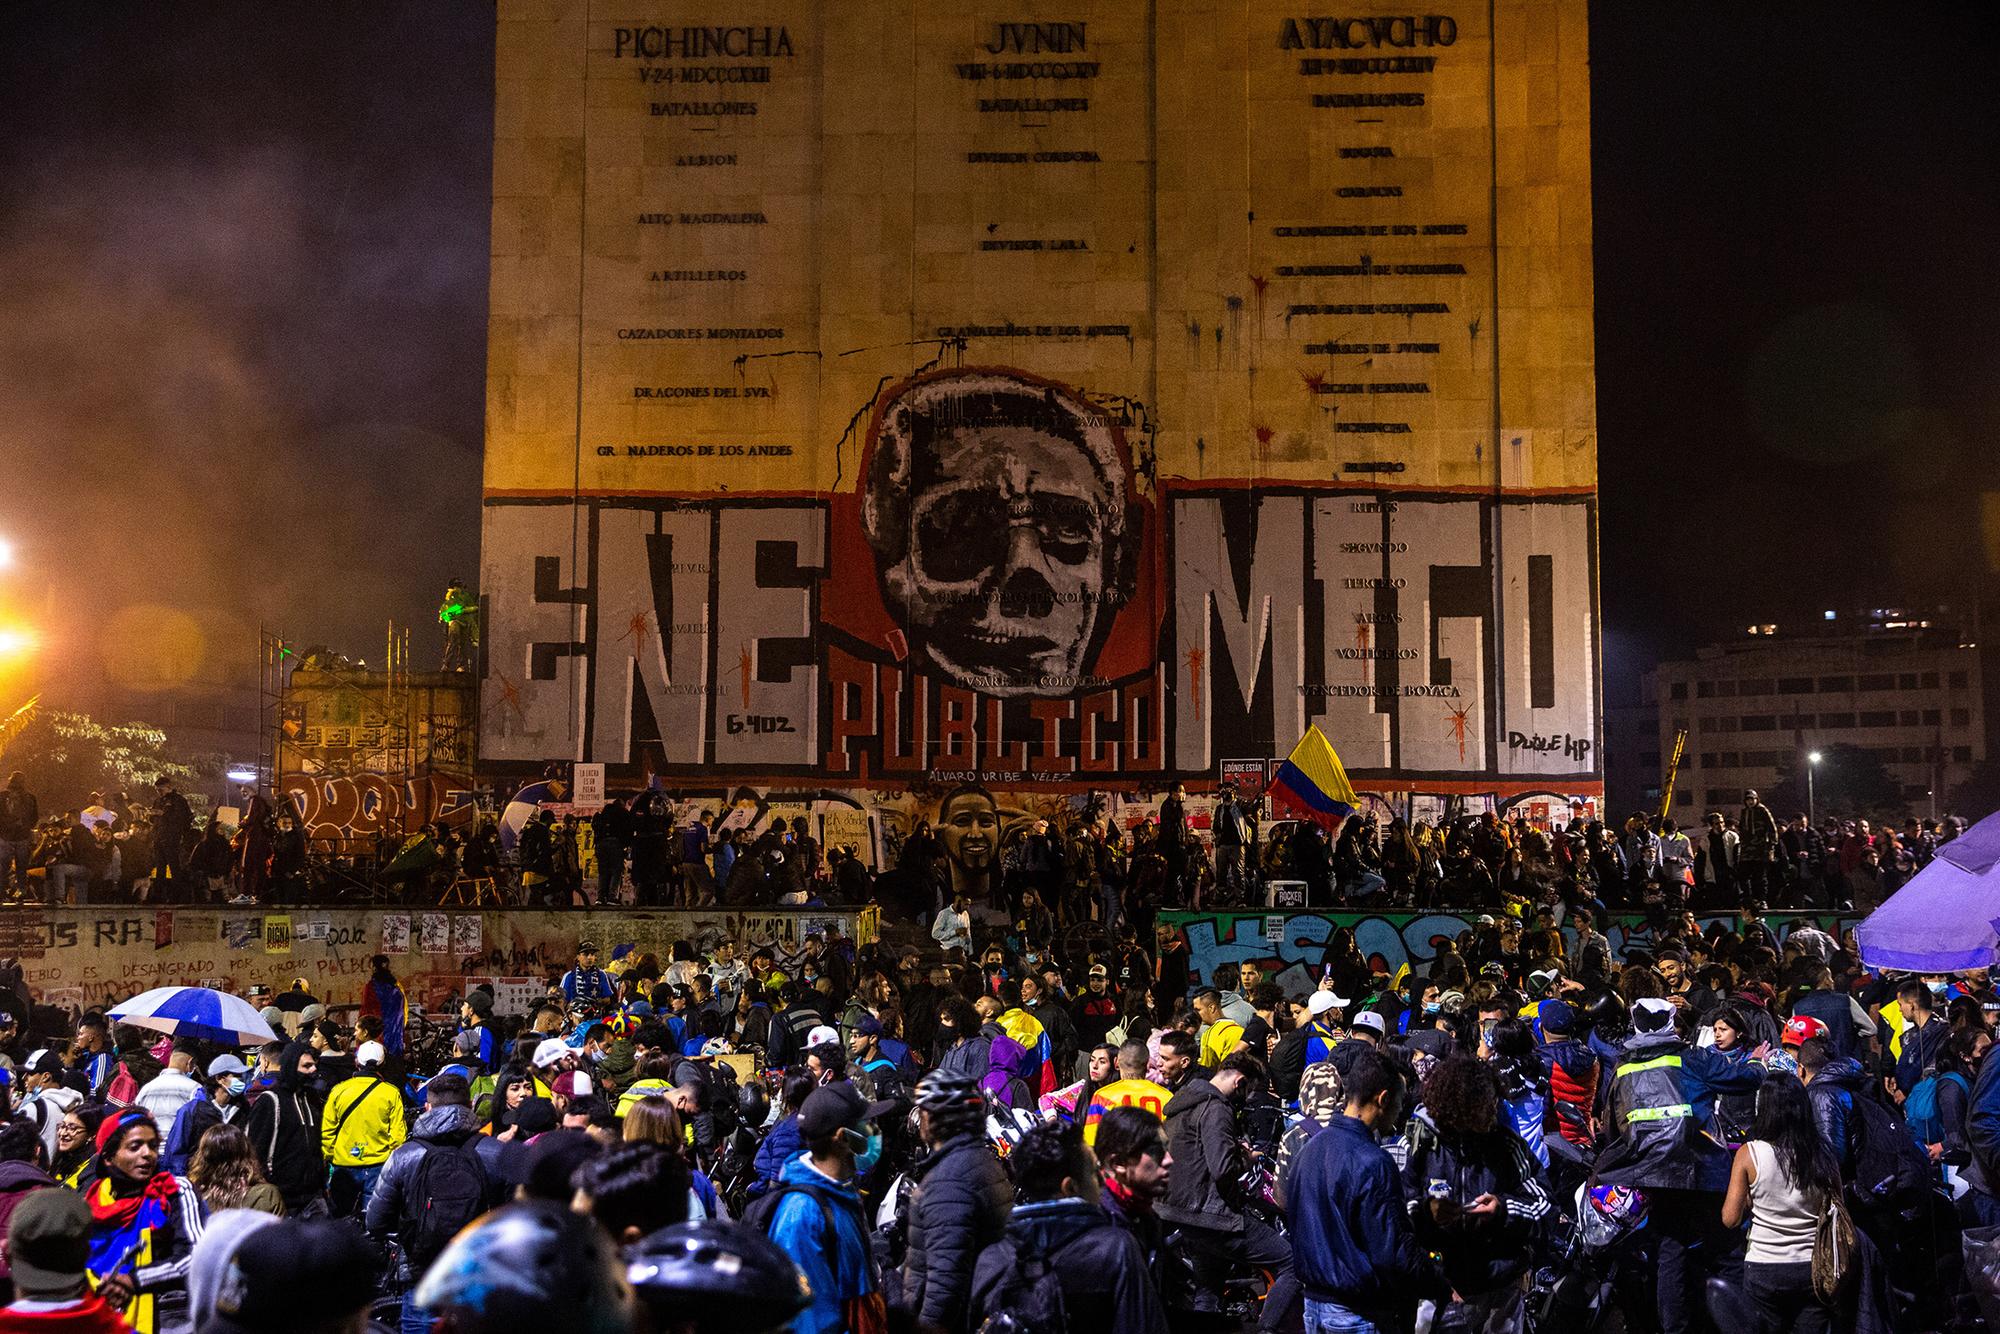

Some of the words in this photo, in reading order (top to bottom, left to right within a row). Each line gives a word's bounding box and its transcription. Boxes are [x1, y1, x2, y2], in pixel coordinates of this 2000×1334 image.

[986, 22, 1087, 54] JVNIN
[1282, 16, 1457, 49] AYACVCHO
[614, 26, 794, 58] PICHINCHA
[651, 103, 757, 116] BATALLONES
[676, 154, 737, 166] ALBION
[680, 212, 768, 224] MAGDALENA
[651, 271, 748, 282] ARTILLEROS
[618, 328, 703, 339] CAZADORES
[707, 328, 784, 339] MONTADOS
[634, 387, 710, 398] DRAGONES
[714, 387, 738, 397] DEL
[744, 387, 771, 397] SVR
[698, 446, 714, 456] DE
[719, 446, 744, 456] LOS
[748, 446, 793, 456] ANDES
[929, 769, 976, 782] ÁLVARO
[982, 771, 1022, 782] URIBE
[1031, 771, 1072, 783] VÉLEZ
[1279, 890, 1303, 904] ROCKER
[267, 925, 289, 942] DIGNA
[83, 966, 98, 978] ES
[122, 959, 214, 978] DESANGRADO
